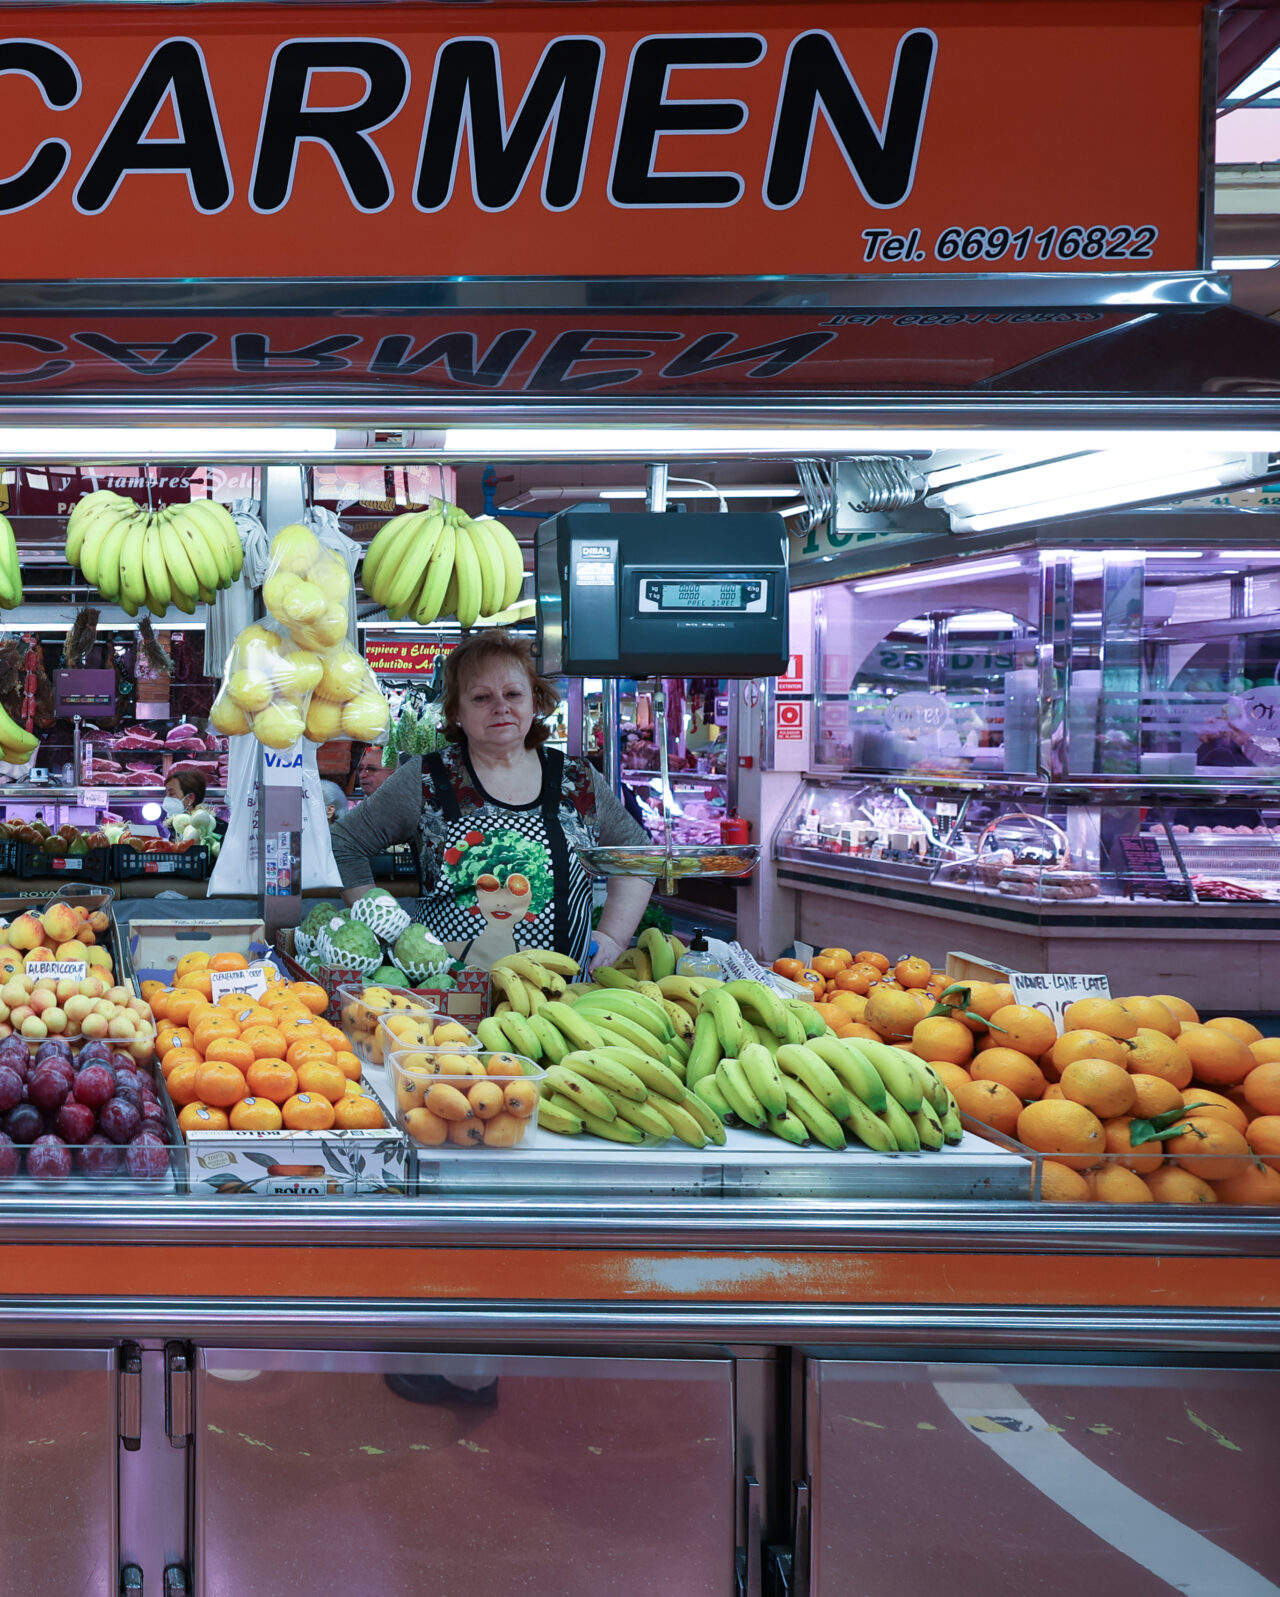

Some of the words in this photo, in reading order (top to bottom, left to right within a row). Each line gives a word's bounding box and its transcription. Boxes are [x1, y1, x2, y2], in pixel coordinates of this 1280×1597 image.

[862, 228, 927, 263] Tel.
[935, 224, 1158, 262] 669116822
[582, 547, 610, 555] DIBAL
[366, 644, 398, 656] espiece
[366, 658, 413, 669] mbutidos
